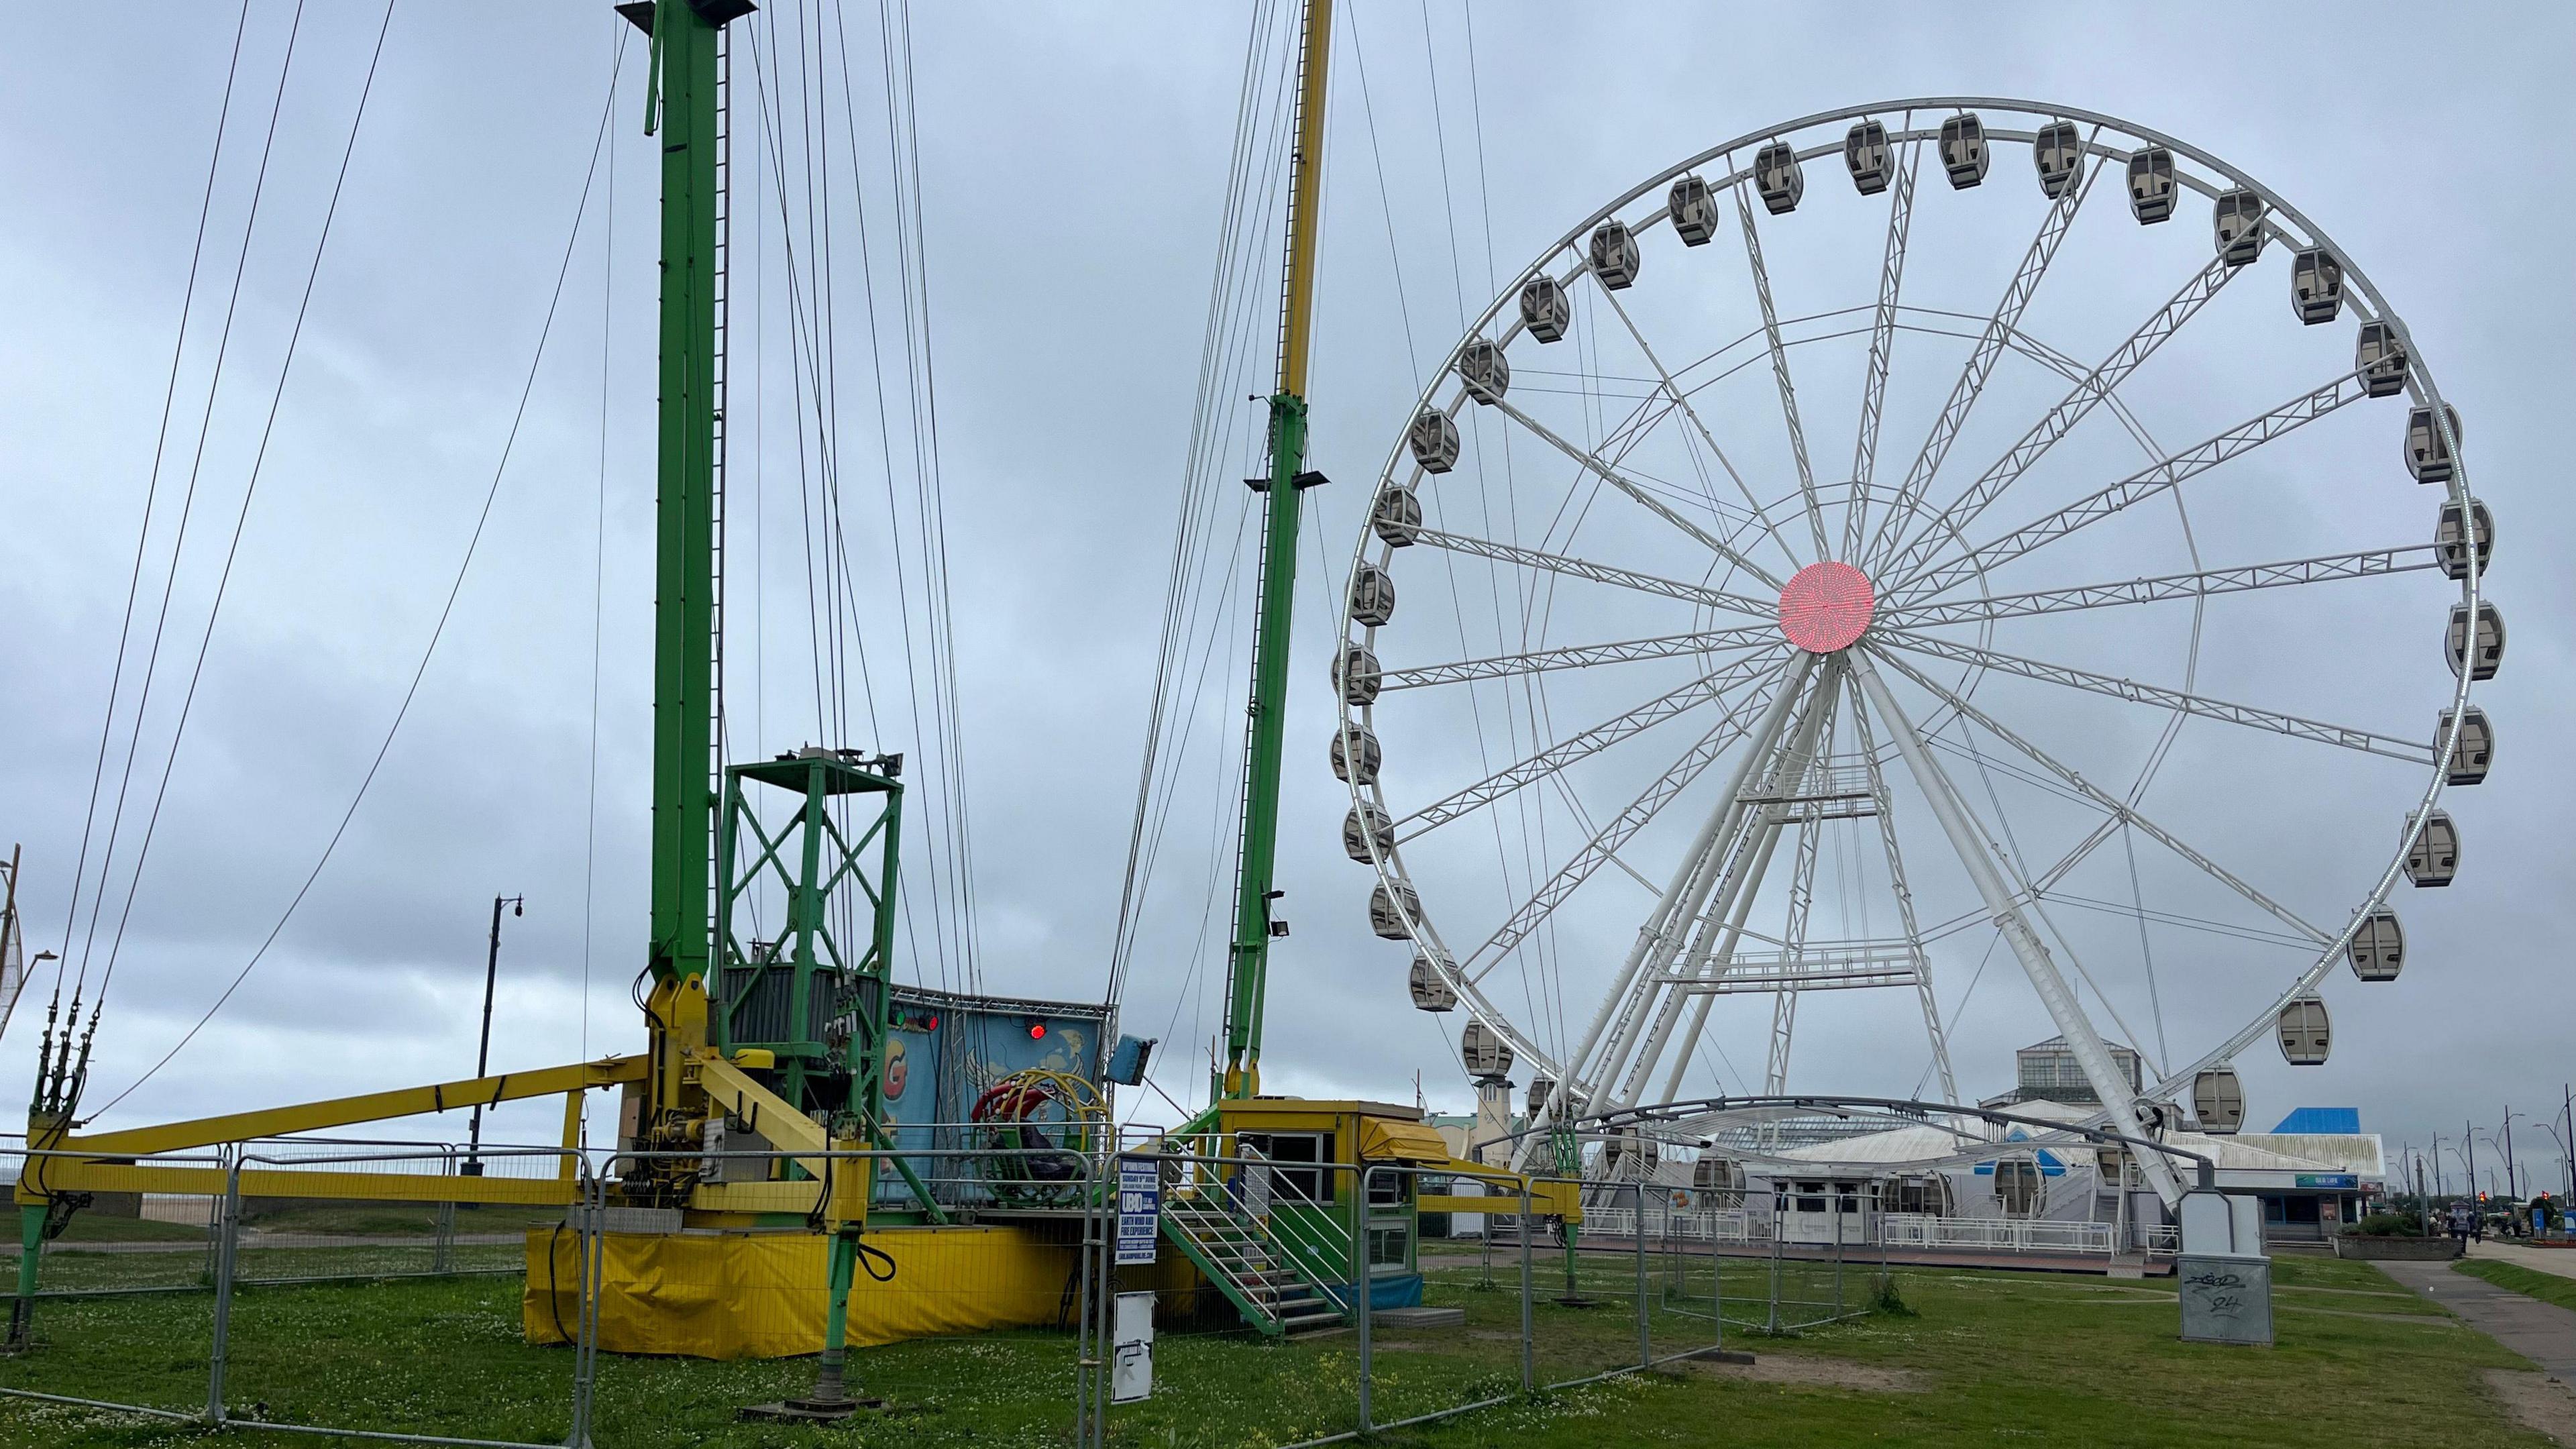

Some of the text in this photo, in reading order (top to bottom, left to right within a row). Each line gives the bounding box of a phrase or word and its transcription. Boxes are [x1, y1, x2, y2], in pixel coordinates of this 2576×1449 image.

[1122, 1175, 1138, 1183] SUNDAY
[1145, 1175, 1156, 1183] JUNE
[1122, 1192, 1143, 1213] UB40
[1121, 1216, 1134, 1226] EARTH
[1145, 1216, 1154, 1226] AND
[1120, 1226, 1154, 1236] FIRE EXPERIENCE
